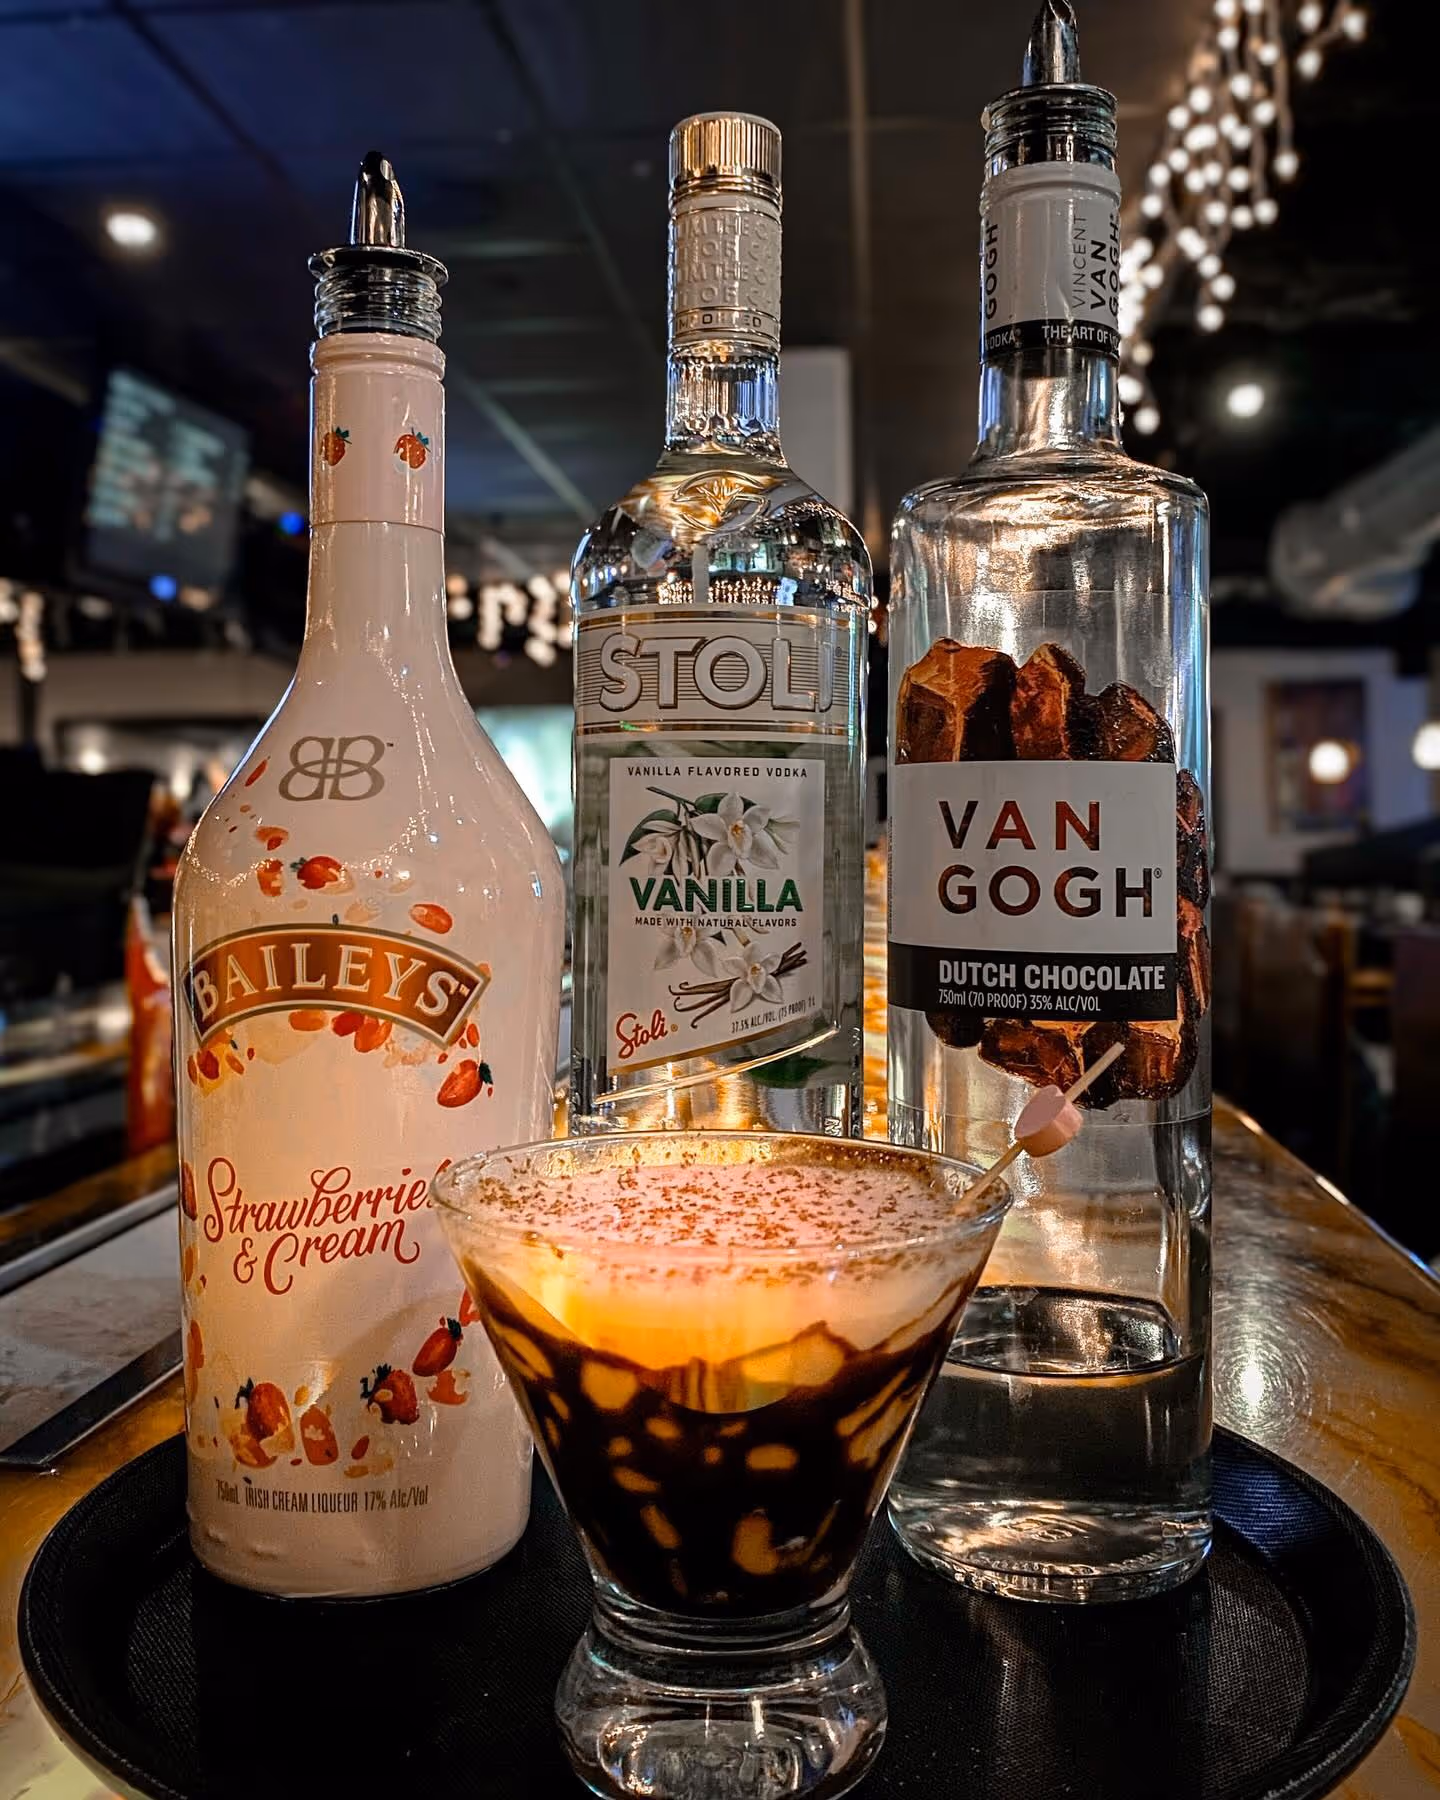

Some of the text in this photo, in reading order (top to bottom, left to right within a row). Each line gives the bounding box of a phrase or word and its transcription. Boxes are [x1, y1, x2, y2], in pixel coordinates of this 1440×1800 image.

[985, 223, 998, 320] GOGH
[1072, 213, 1086, 309] VINCENT
[1090, 239, 1107, 310] VAN
[1108, 221, 1120, 318] GOGH
[1041, 324, 1068, 340] THE
[1071, 326, 1095, 341] ART
[1096, 330, 1108, 344] OF
[600, 632, 833, 712] STOLI
[627, 766, 808, 778] VANILLA FLAVORED VODKA
[938, 800, 1100, 851] VAN
[629, 876, 804, 913] VANILLA
[938, 864, 1153, 918] GOGH
[635, 917, 797, 927] MADE WITH NATURAL FLAVORS
[192, 943, 461, 1022] BAILEYS
[938, 988, 1101, 1012] 750ml (70 PROOF) 35% ALC/VOL
[939, 960, 1166, 991] DUTCH CHOCOLATE
[616, 1009, 669, 1060] Stoli
[233, 1219, 420, 1295] & Cream
[216, 1480, 429, 1513] 750mL IRISH CREAM LIQUEUR 17% Alc/Vol
